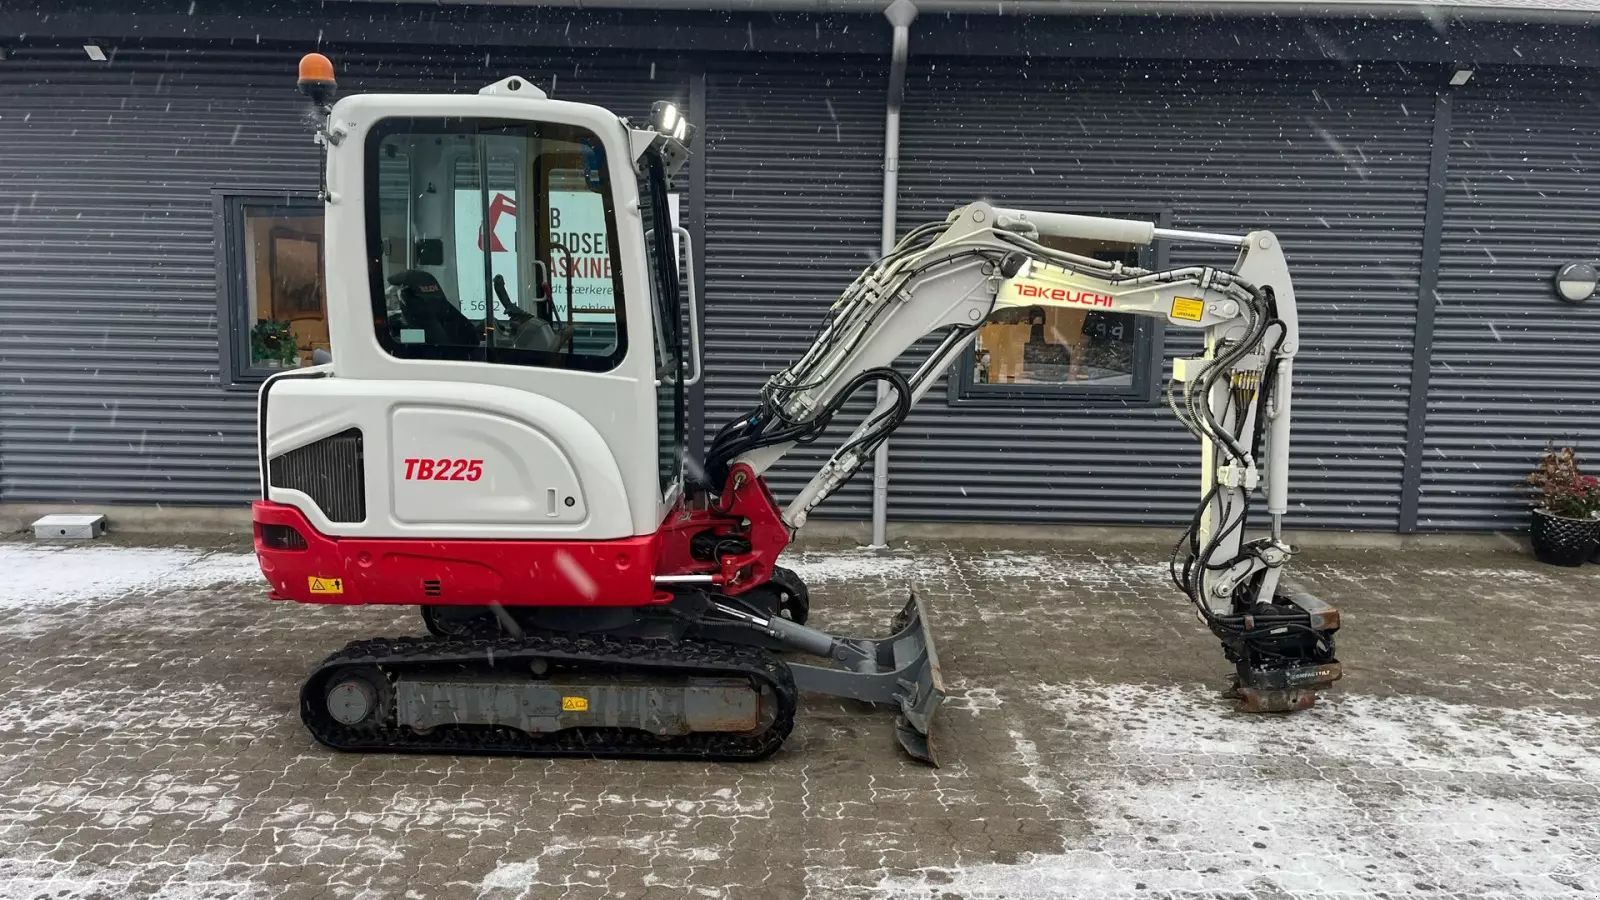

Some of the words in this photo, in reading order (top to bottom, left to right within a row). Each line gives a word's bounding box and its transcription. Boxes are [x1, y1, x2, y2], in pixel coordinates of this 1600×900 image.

[550, 232, 609, 255] RIDSE
[551, 283, 562, 294] dt
[1014, 283, 1114, 308] TAKEUCHI
[404, 458, 484, 482] TB225
